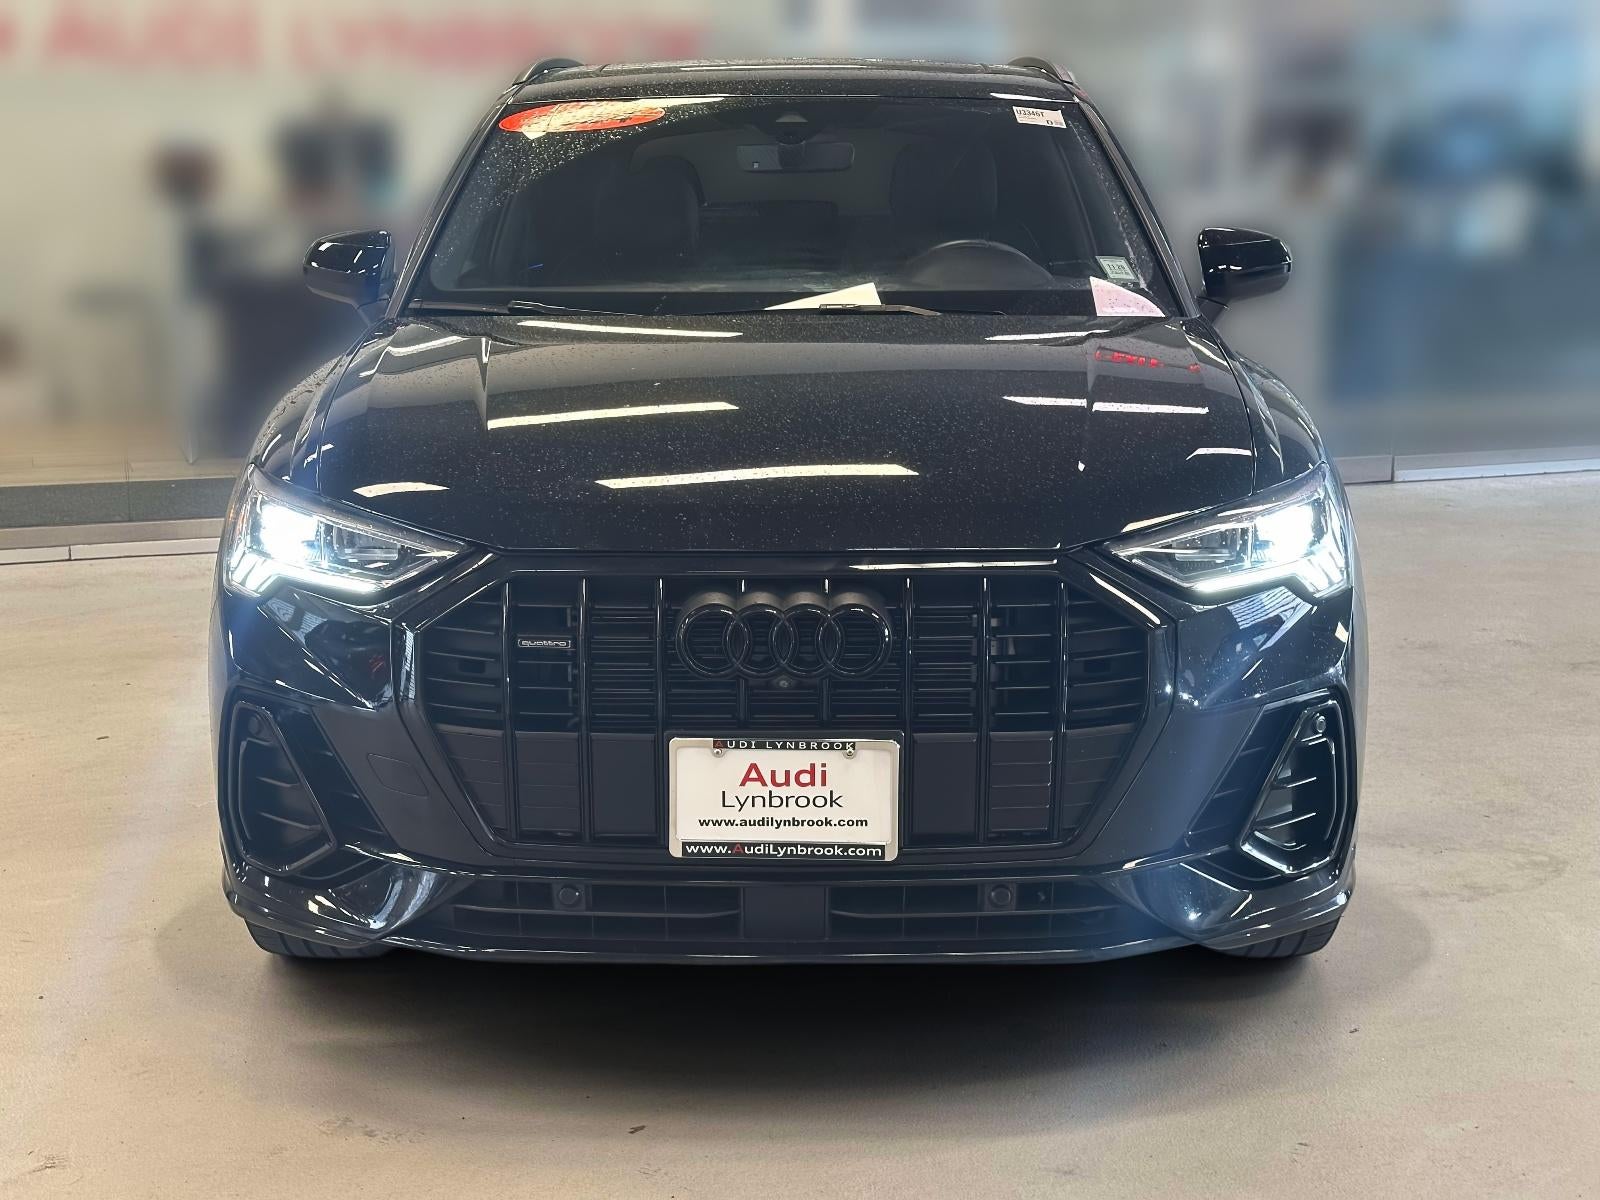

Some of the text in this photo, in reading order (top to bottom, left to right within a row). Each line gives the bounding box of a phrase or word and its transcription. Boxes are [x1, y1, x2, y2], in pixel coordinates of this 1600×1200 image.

[715, 740, 855, 751] AUDI LYNBROOK
[739, 762, 828, 788] Audi
[721, 790, 844, 812] Lynbrook
[698, 817, 868, 830] www.audilynbrook.com
[685, 843, 883, 858] www.AudiLynbrook.com
